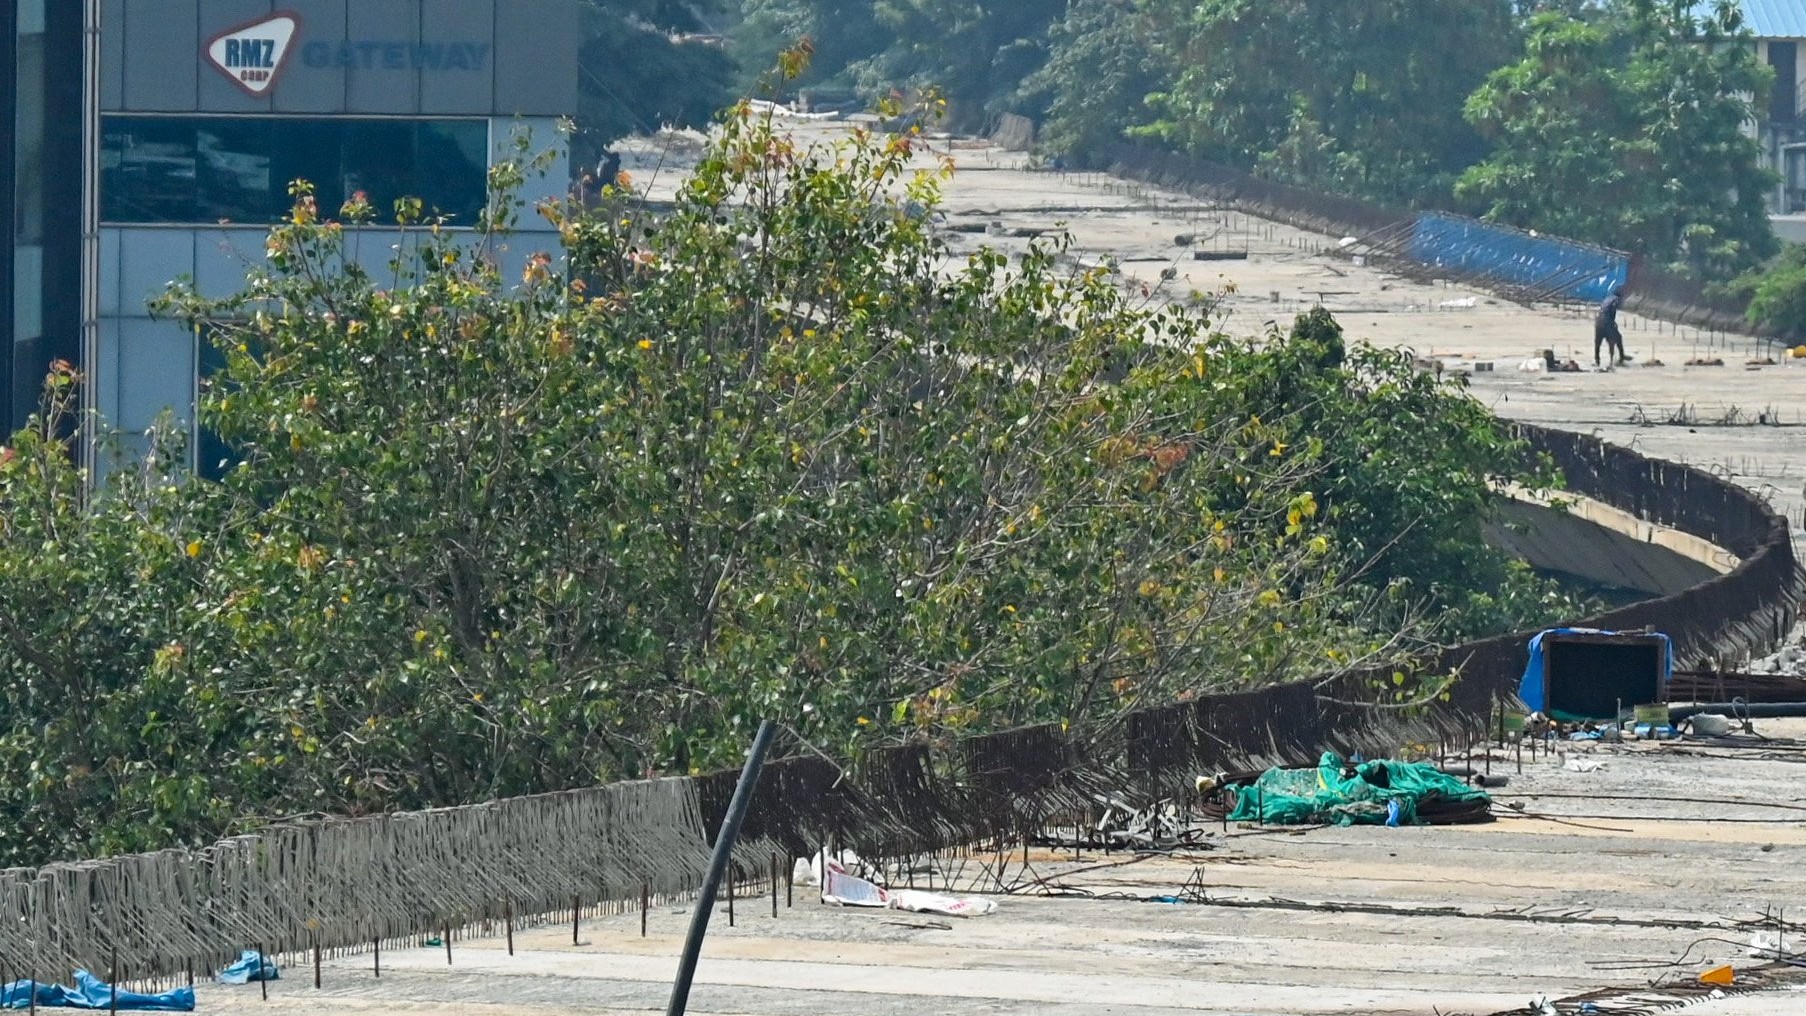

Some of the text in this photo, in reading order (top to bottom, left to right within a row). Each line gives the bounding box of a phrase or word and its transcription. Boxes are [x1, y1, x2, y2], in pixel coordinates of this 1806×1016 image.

[224, 38, 275, 68] RMZ
[301, 40, 489, 70] GATEWAY
[240, 69, 270, 82] CORP
